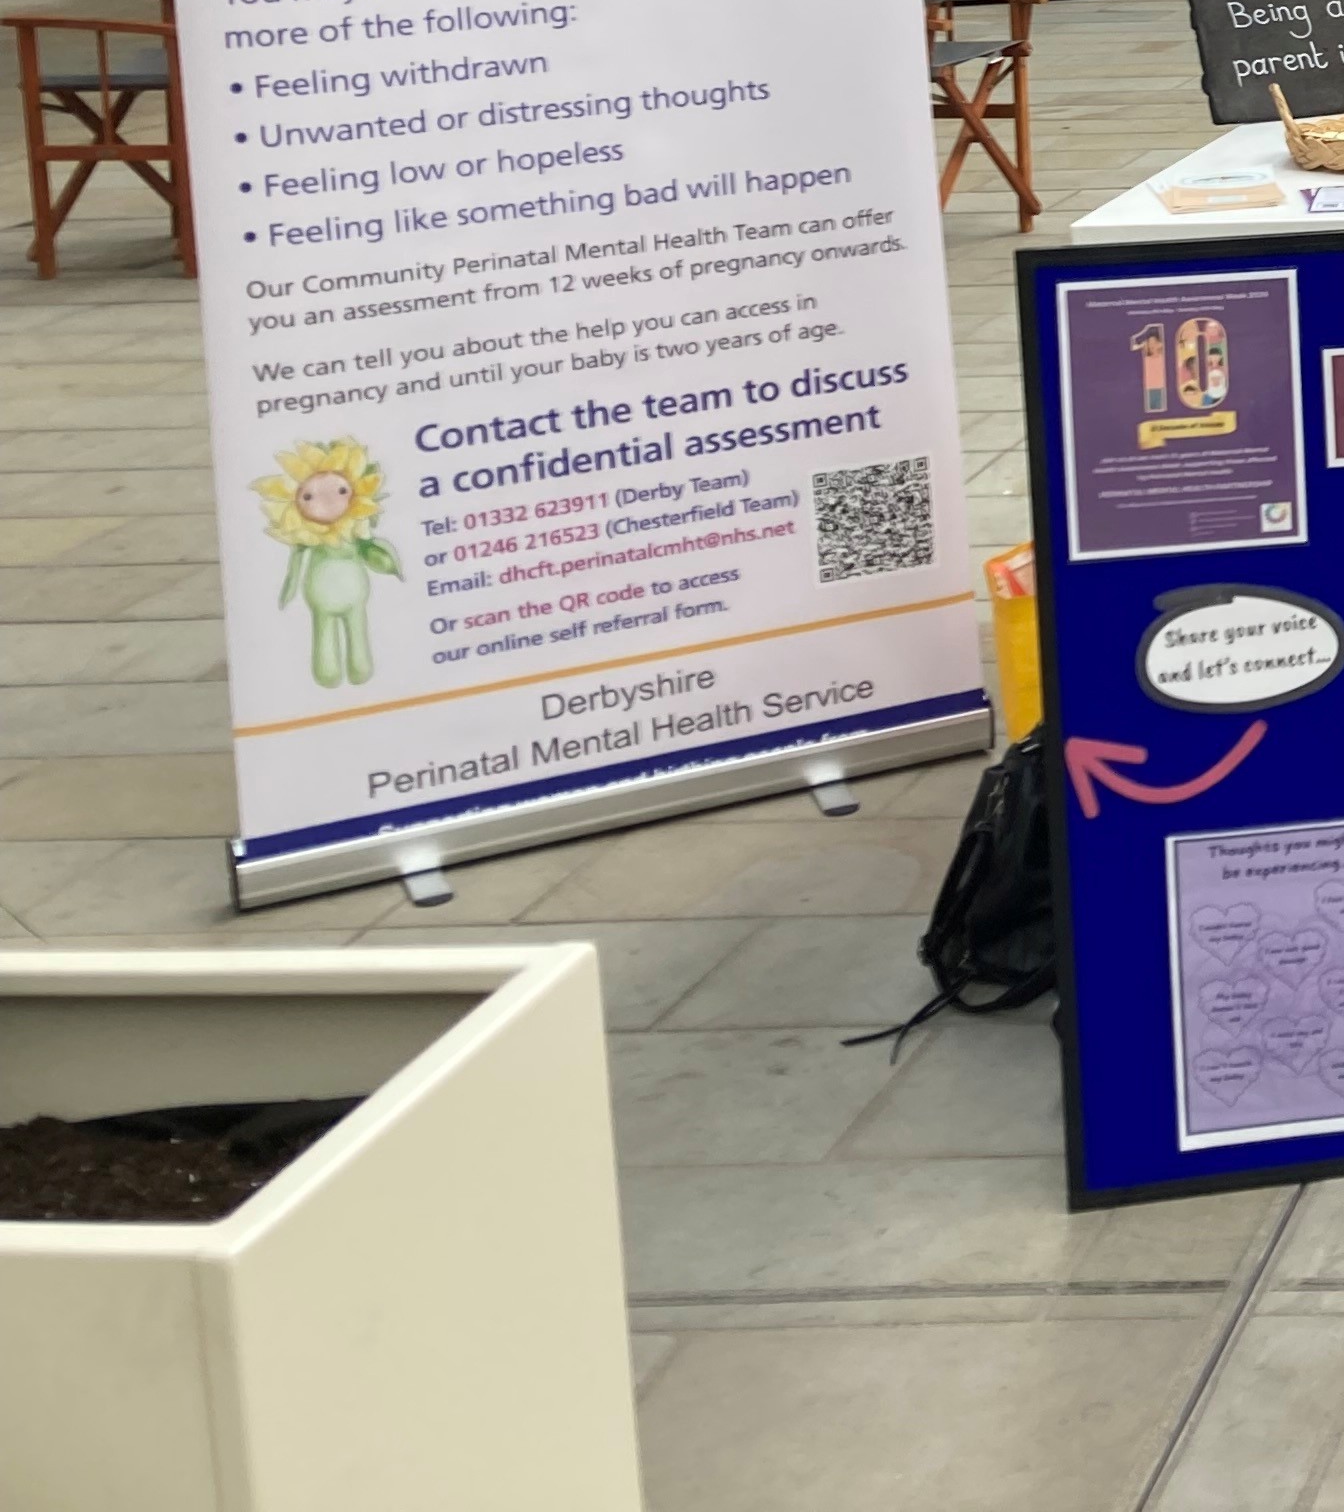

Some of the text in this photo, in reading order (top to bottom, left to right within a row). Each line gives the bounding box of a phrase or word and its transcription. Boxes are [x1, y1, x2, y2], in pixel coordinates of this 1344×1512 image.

[1226, 1, 1313, 39] Being
[1232, 40, 1330, 88] parent
[1129, 317, 1229, 413] 10
[415, 362, 909, 453] Contact the team to discuss
[419, 405, 882, 498] a confidential assessment
[420, 468, 750, 537] Tel: 01332 623911 (Derby Team)
[426, 520, 796, 597] Email: dhcft.perinatalcmht@nhs.net
[1162, 614, 1319, 648] Share your voice
[1157, 664, 1192, 686] and
[1199, 658, 1239, 680] let's
